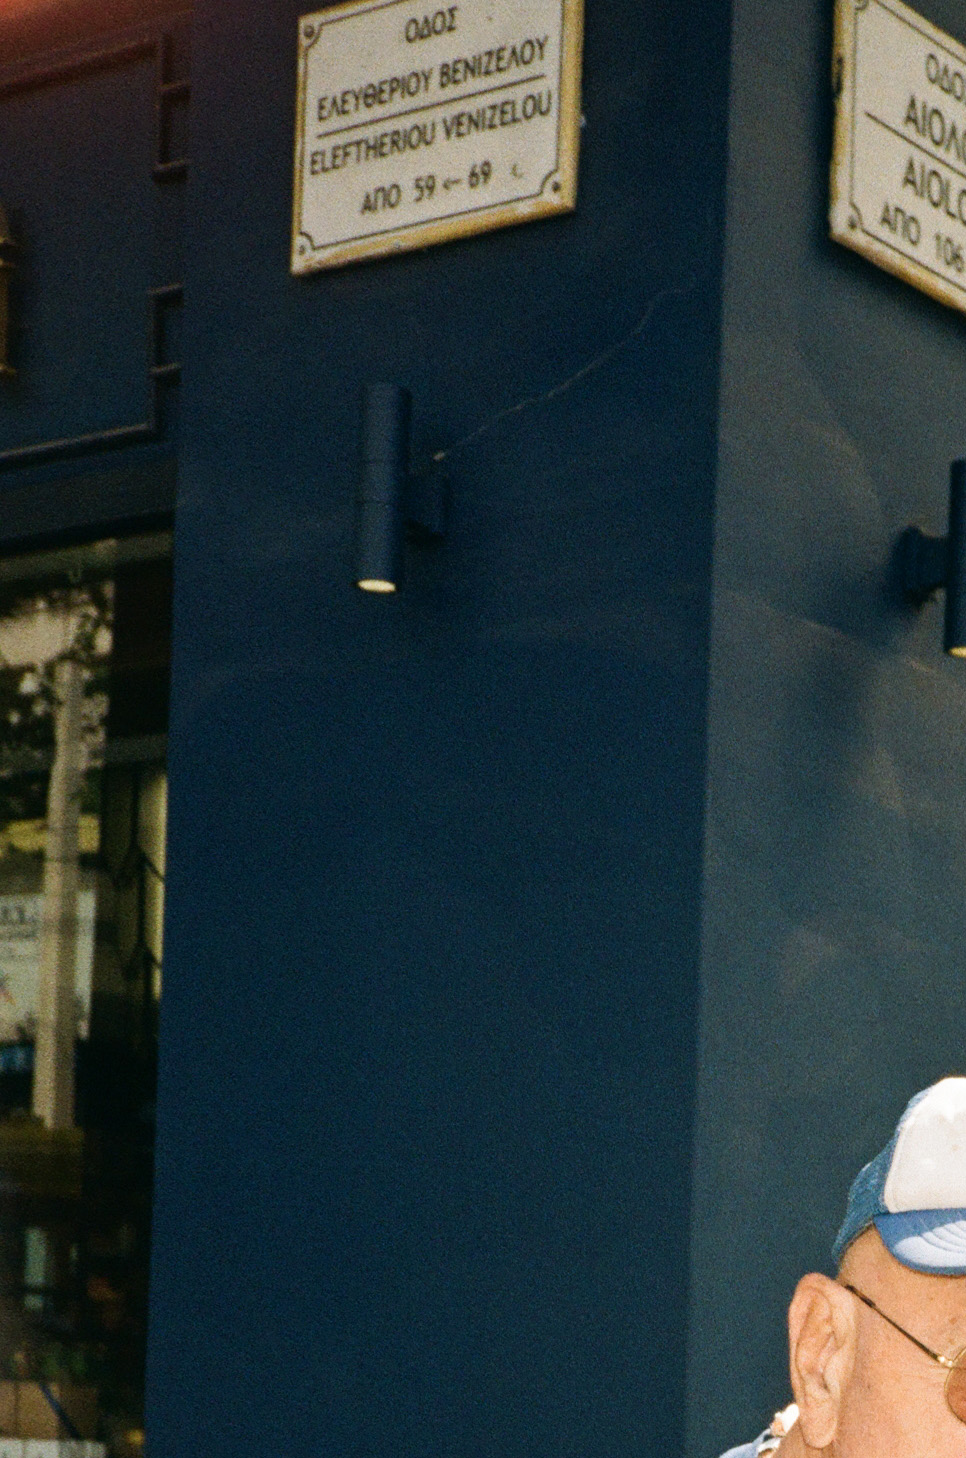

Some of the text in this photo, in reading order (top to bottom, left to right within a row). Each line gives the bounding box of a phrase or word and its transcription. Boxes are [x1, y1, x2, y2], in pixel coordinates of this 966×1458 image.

[405, 7, 457, 43] ΟΔΟΣ
[317, 35, 549, 122] ΕΛΕΥΘΕΡΙΟΥ ΒΕΝΙΖΕΛΟΥ
[310, 90, 551, 176] ELEFTHERIOU VENIZELOU
[361, 184, 400, 215] ΑΠΟ
[880, 204, 921, 246] ΑΠΟ
